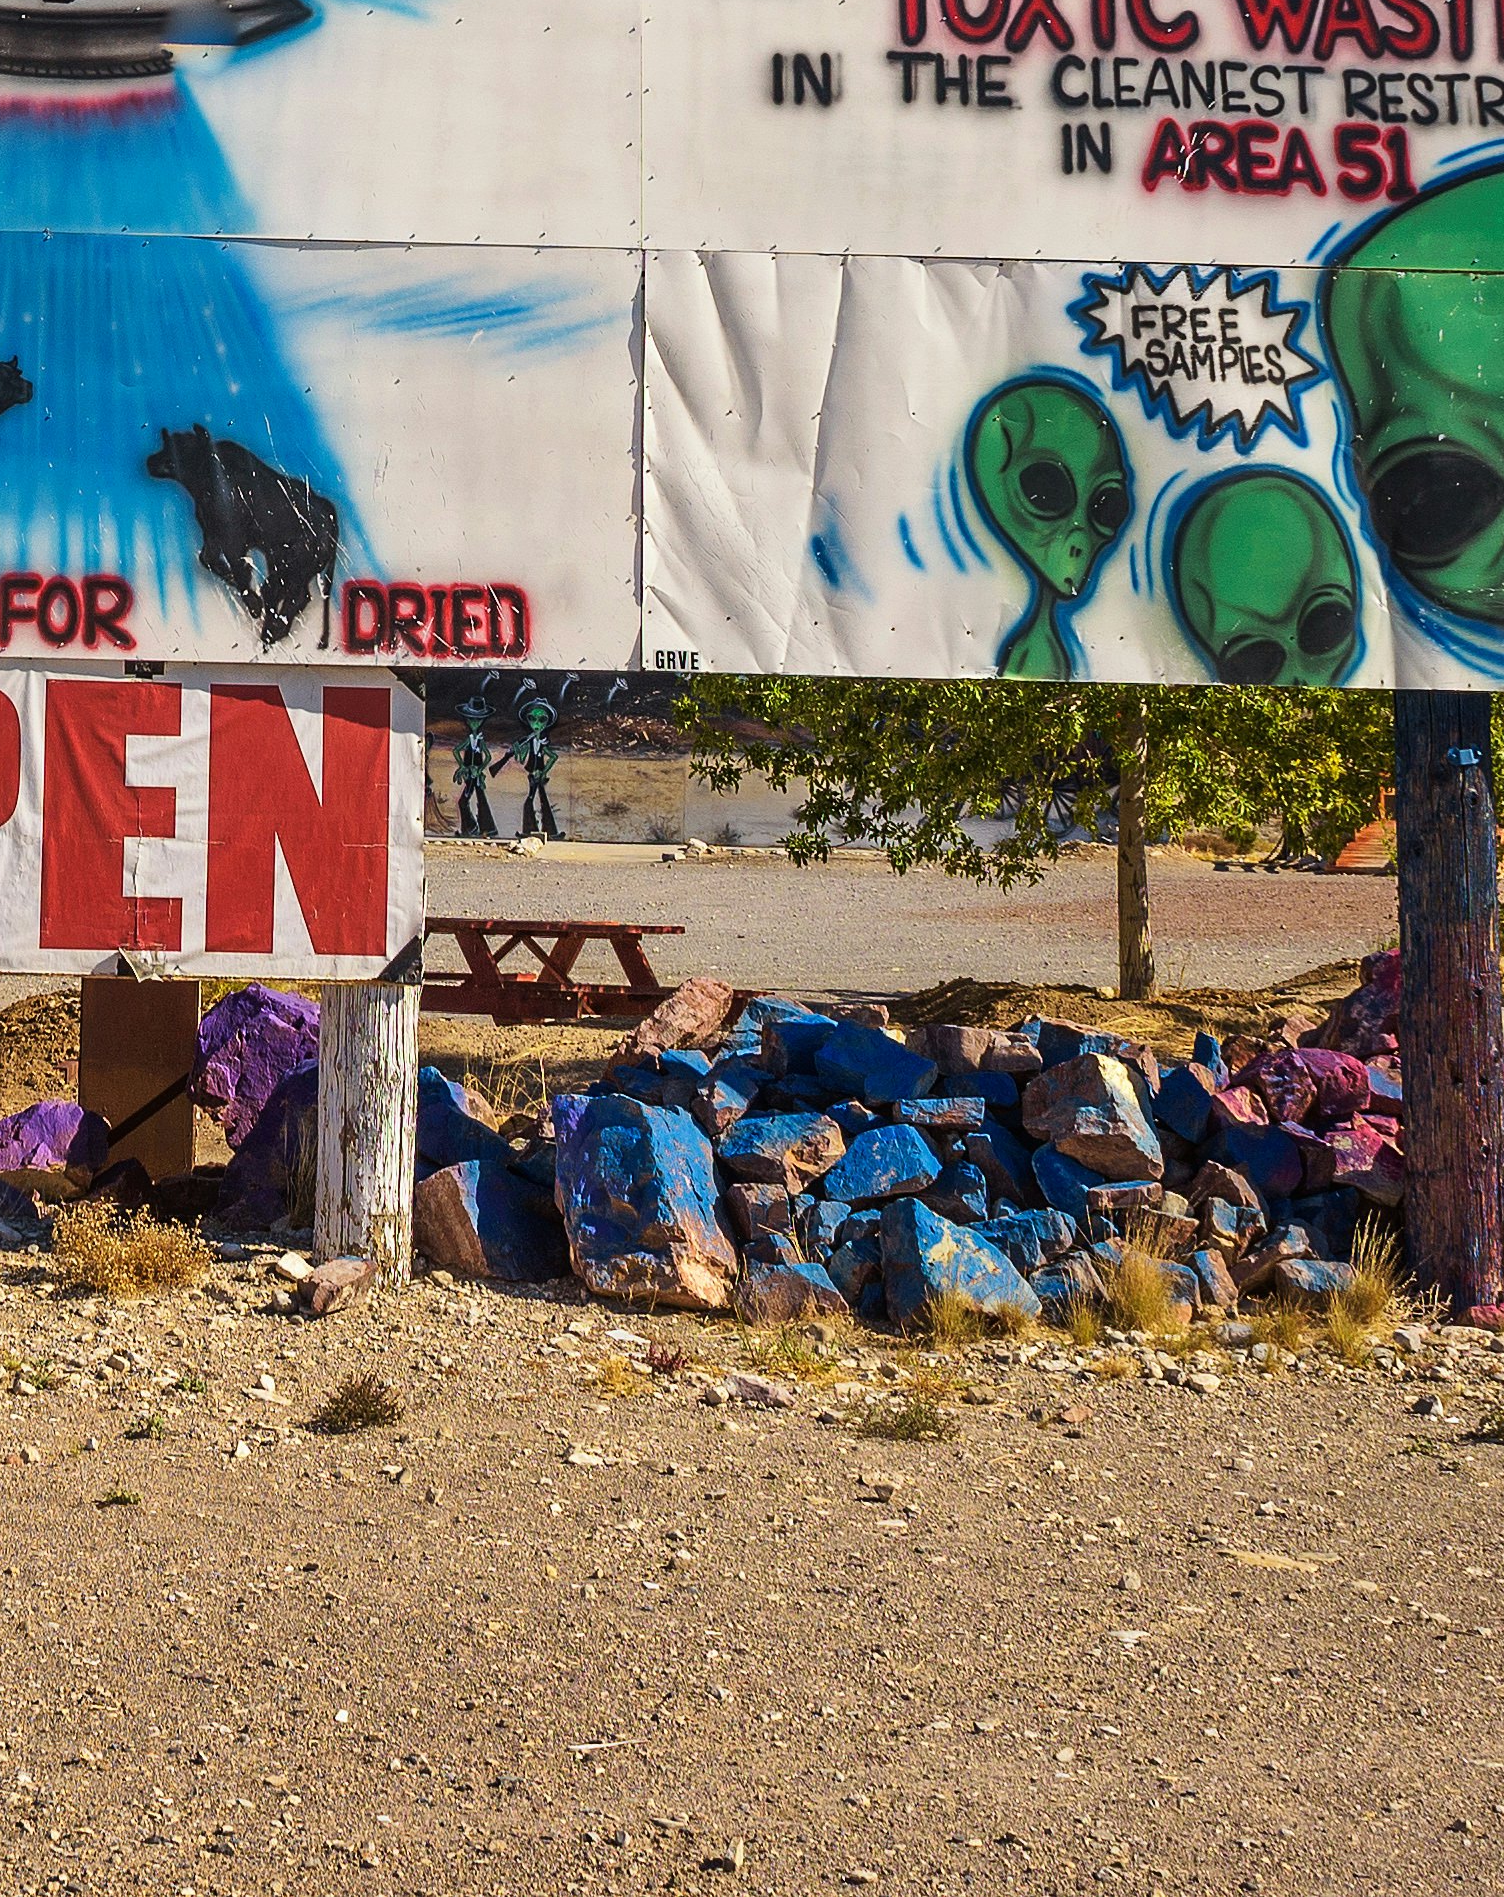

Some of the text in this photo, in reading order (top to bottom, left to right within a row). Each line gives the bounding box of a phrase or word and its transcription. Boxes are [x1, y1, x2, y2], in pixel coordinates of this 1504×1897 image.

[772, 52, 834, 105] IN
[887, 50, 1015, 109] THE
[1051, 57, 1324, 119] CLEANEST
[1061, 116, 1419, 202] IN AREA 51
[1131, 304, 1241, 344] FREE
[340, 580, 531, 658] DRIED
[655, 650, 699, 670] GRVE
